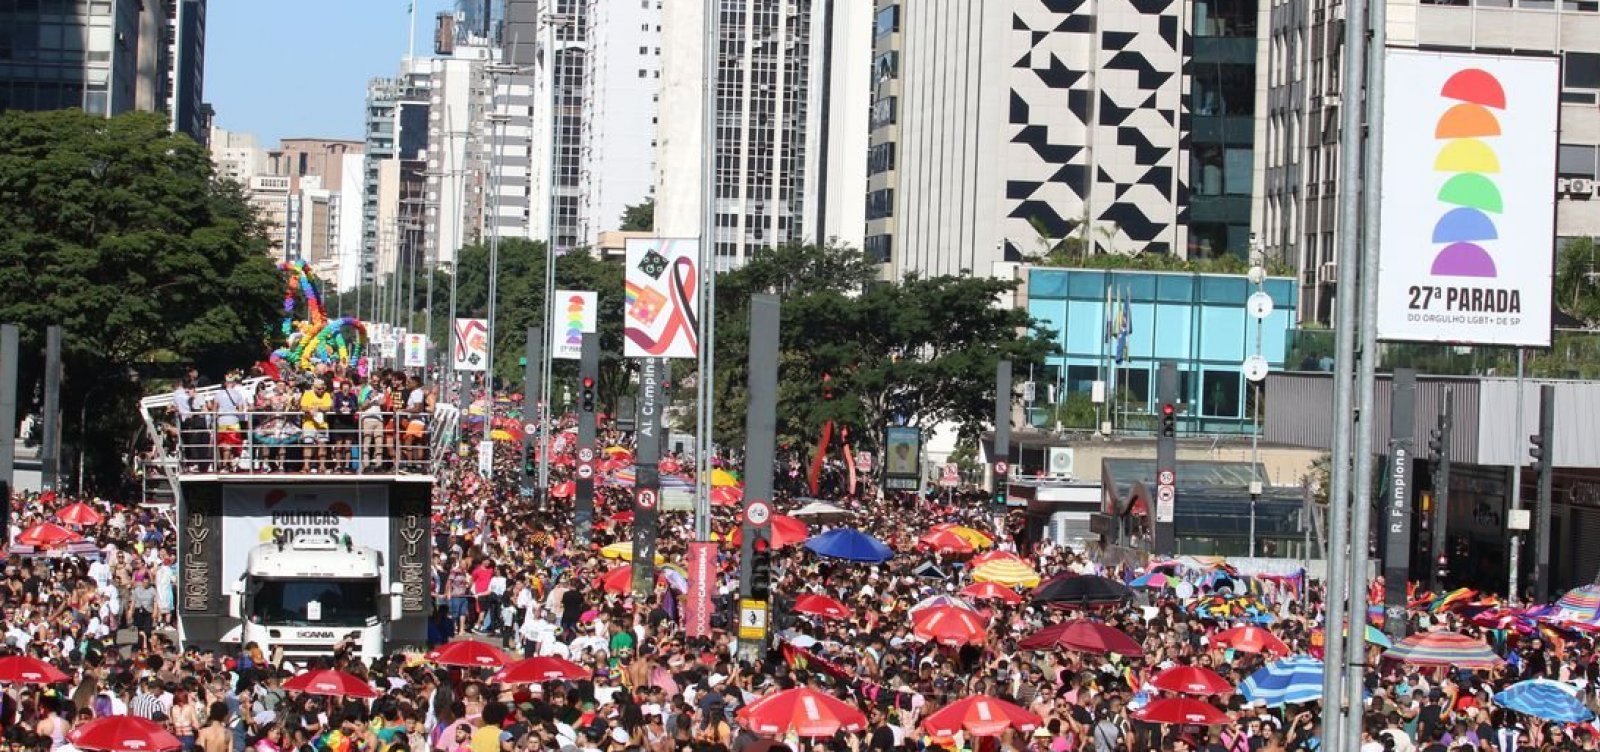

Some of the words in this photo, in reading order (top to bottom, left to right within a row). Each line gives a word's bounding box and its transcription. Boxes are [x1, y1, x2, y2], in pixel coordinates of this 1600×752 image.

[1408, 285, 1442, 310] 27ª
[1446, 286, 1521, 313] PARADA
[1407, 313, 1421, 322] DO
[1422, 314, 1465, 324] ORGULHO
[1467, 315, 1494, 325] LGBT+
[1496, 316, 1508, 326] DE
[1510, 317, 1521, 326] SP
[581, 450, 591, 458] 50
[1391, 521, 1402, 533] R.
[296, 631, 335, 639] SCANIA
